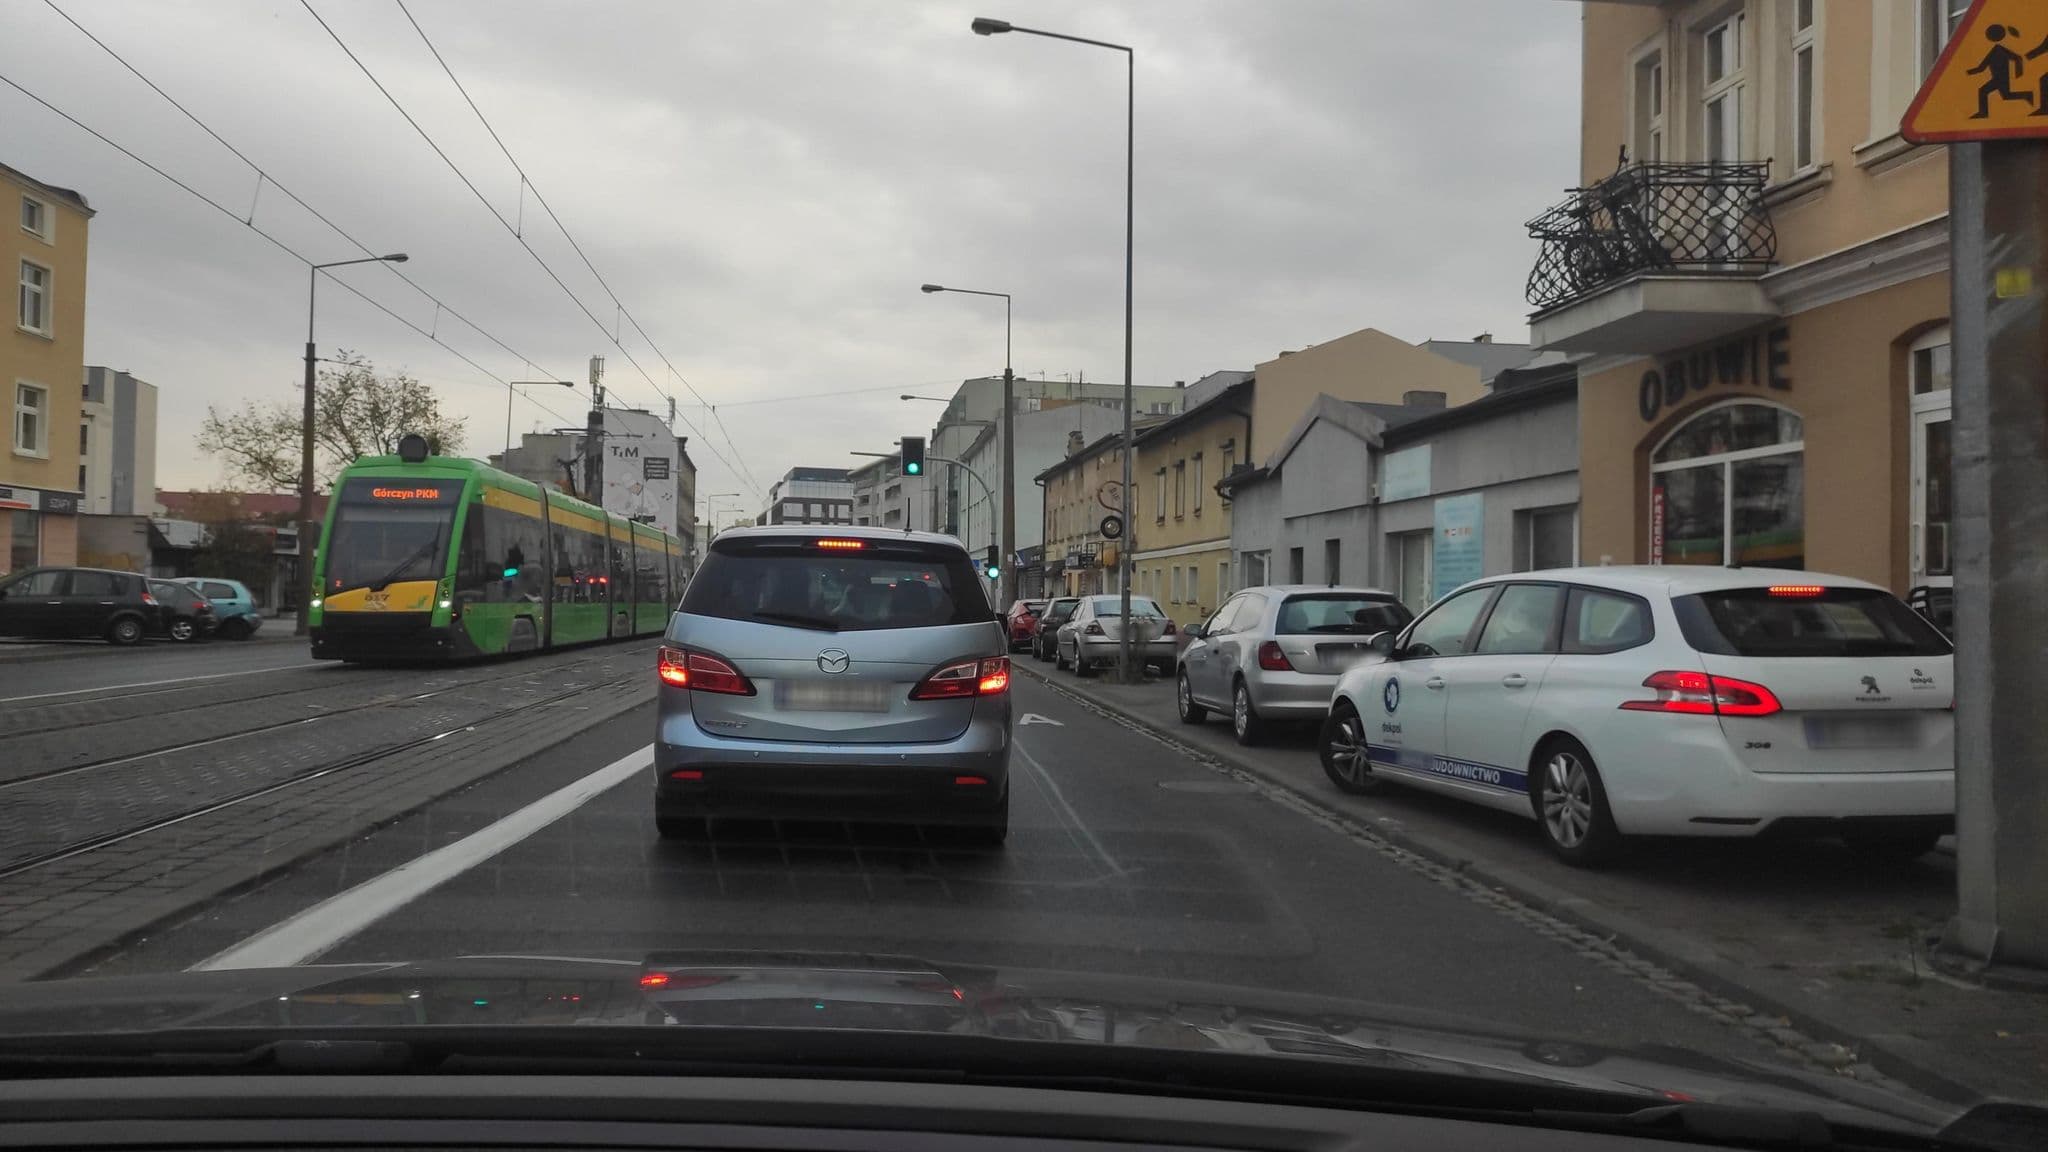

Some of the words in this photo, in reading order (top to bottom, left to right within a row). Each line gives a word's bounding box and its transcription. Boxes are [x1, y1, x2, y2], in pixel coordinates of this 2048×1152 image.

[1640, 328, 1791, 421] OBUWIE
[373, 488, 413, 499] Górczyn
[416, 489, 438, 498] PKM
